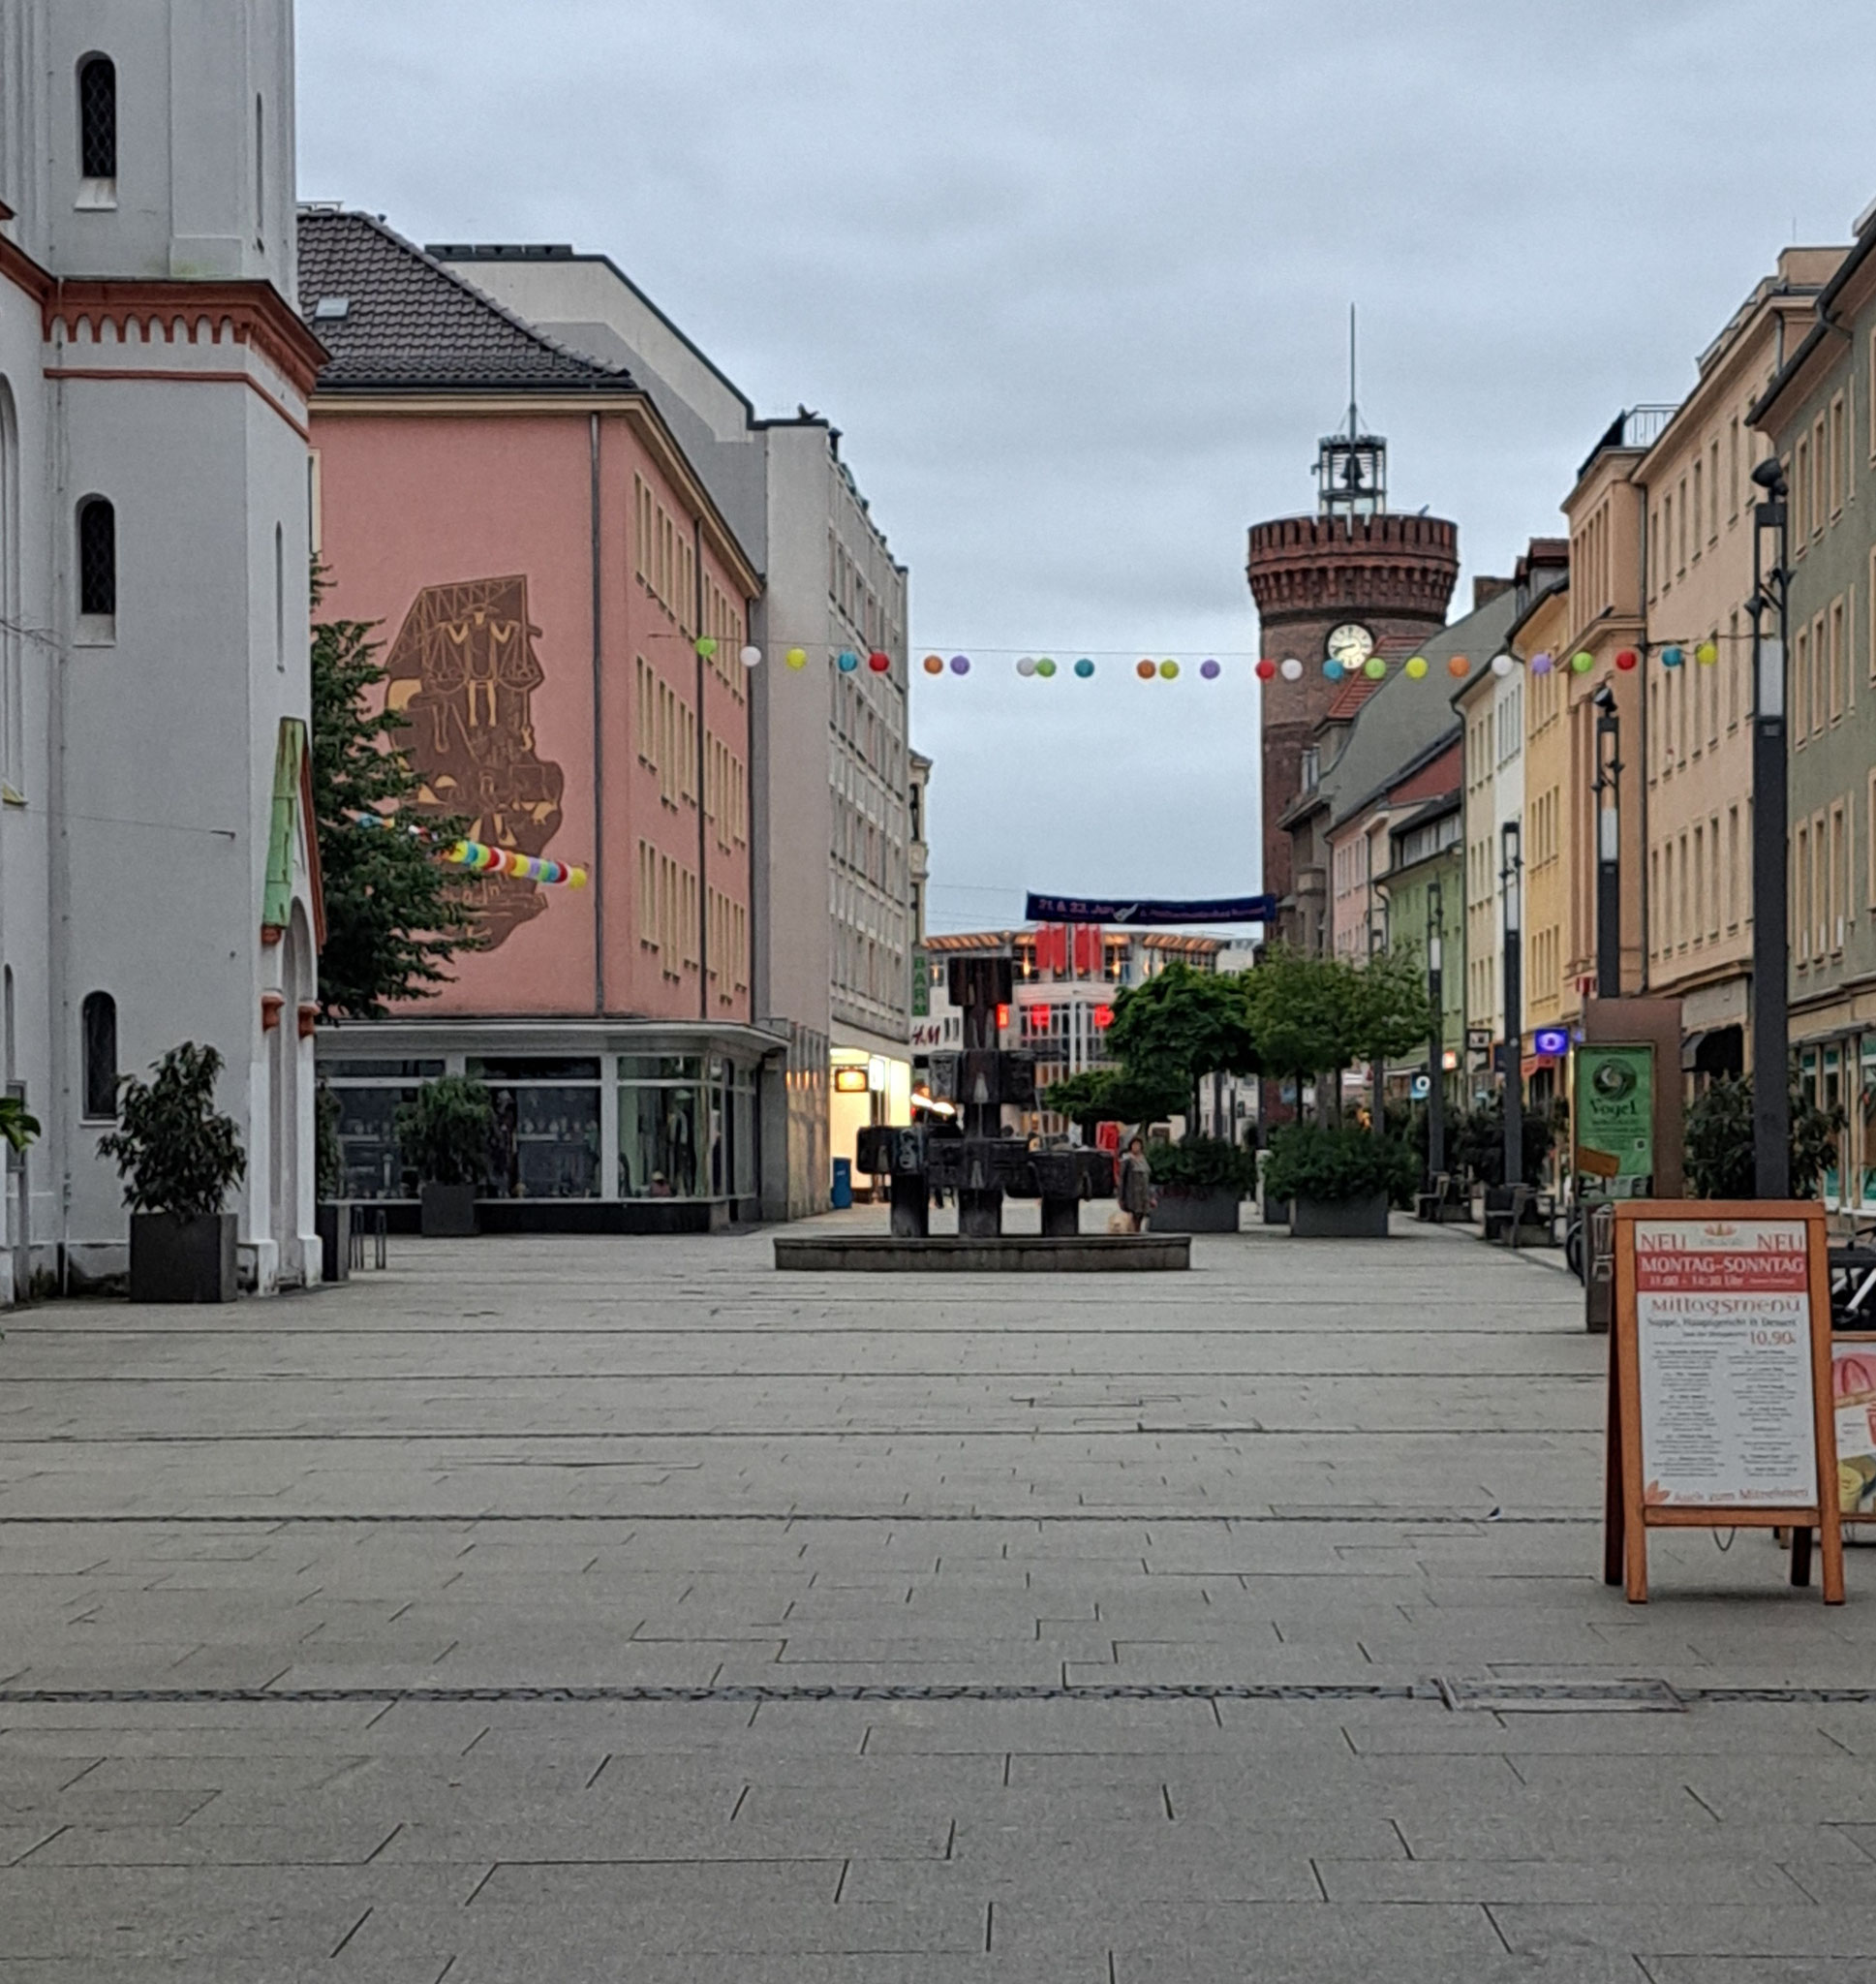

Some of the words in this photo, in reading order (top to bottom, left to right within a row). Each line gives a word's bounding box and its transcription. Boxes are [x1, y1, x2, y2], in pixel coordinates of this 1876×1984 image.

[1641, 1234, 1686, 1251] NEU
[1757, 1234, 1803, 1251] NEU
[1651, 1295, 1800, 1314] Mittagsmenü
